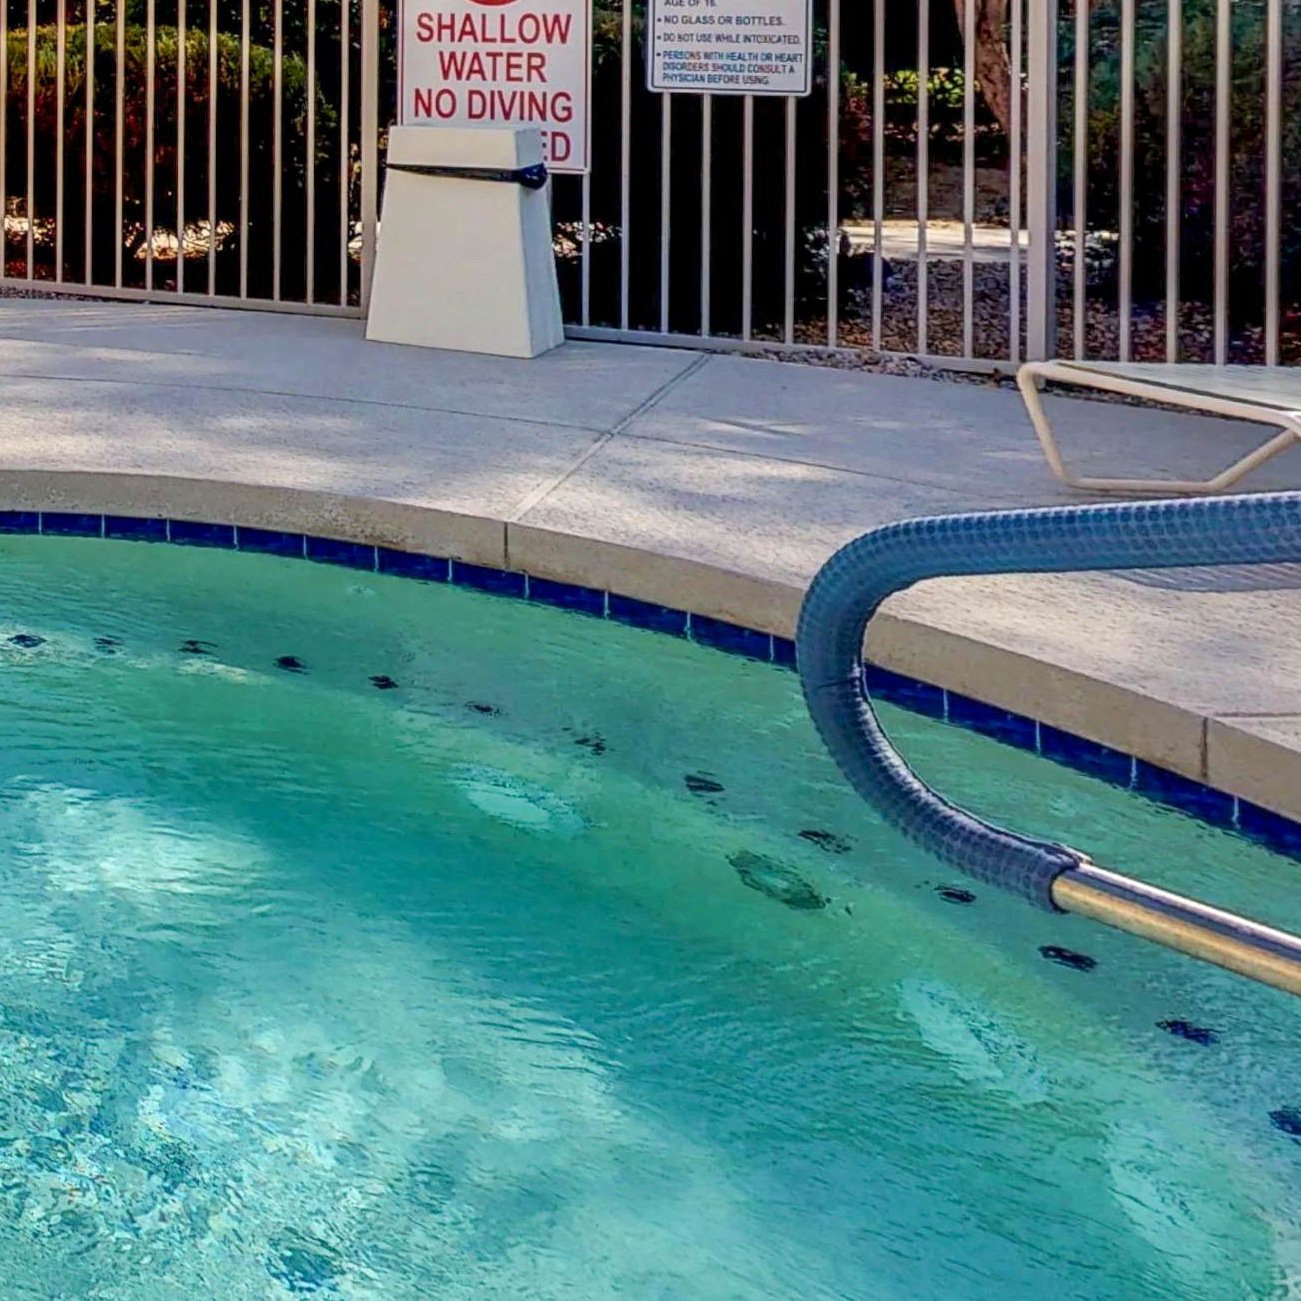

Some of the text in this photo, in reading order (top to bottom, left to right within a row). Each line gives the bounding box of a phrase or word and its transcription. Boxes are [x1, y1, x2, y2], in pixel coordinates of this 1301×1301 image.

[664, 16, 679, 24] NO
[681, 16, 715, 25] GLASS
[718, 16, 732, 25] OR
[416, 13, 572, 44] SHALLOW
[663, 33, 676, 42] DO
[677, 33, 694, 42] NOT
[696, 34, 712, 42] USE
[715, 34, 740, 43] WHILE
[663, 51, 803, 63] PERSONS WITH HEALTH OR HEART
[439, 51, 547, 82] WATER
[663, 63, 795, 73] DISORDERS SHOULD CONSULT A
[663, 74, 705, 83] PHYSICIAN
[707, 74, 741, 84] BEFORE
[414, 88, 573, 123] NO DIVING
